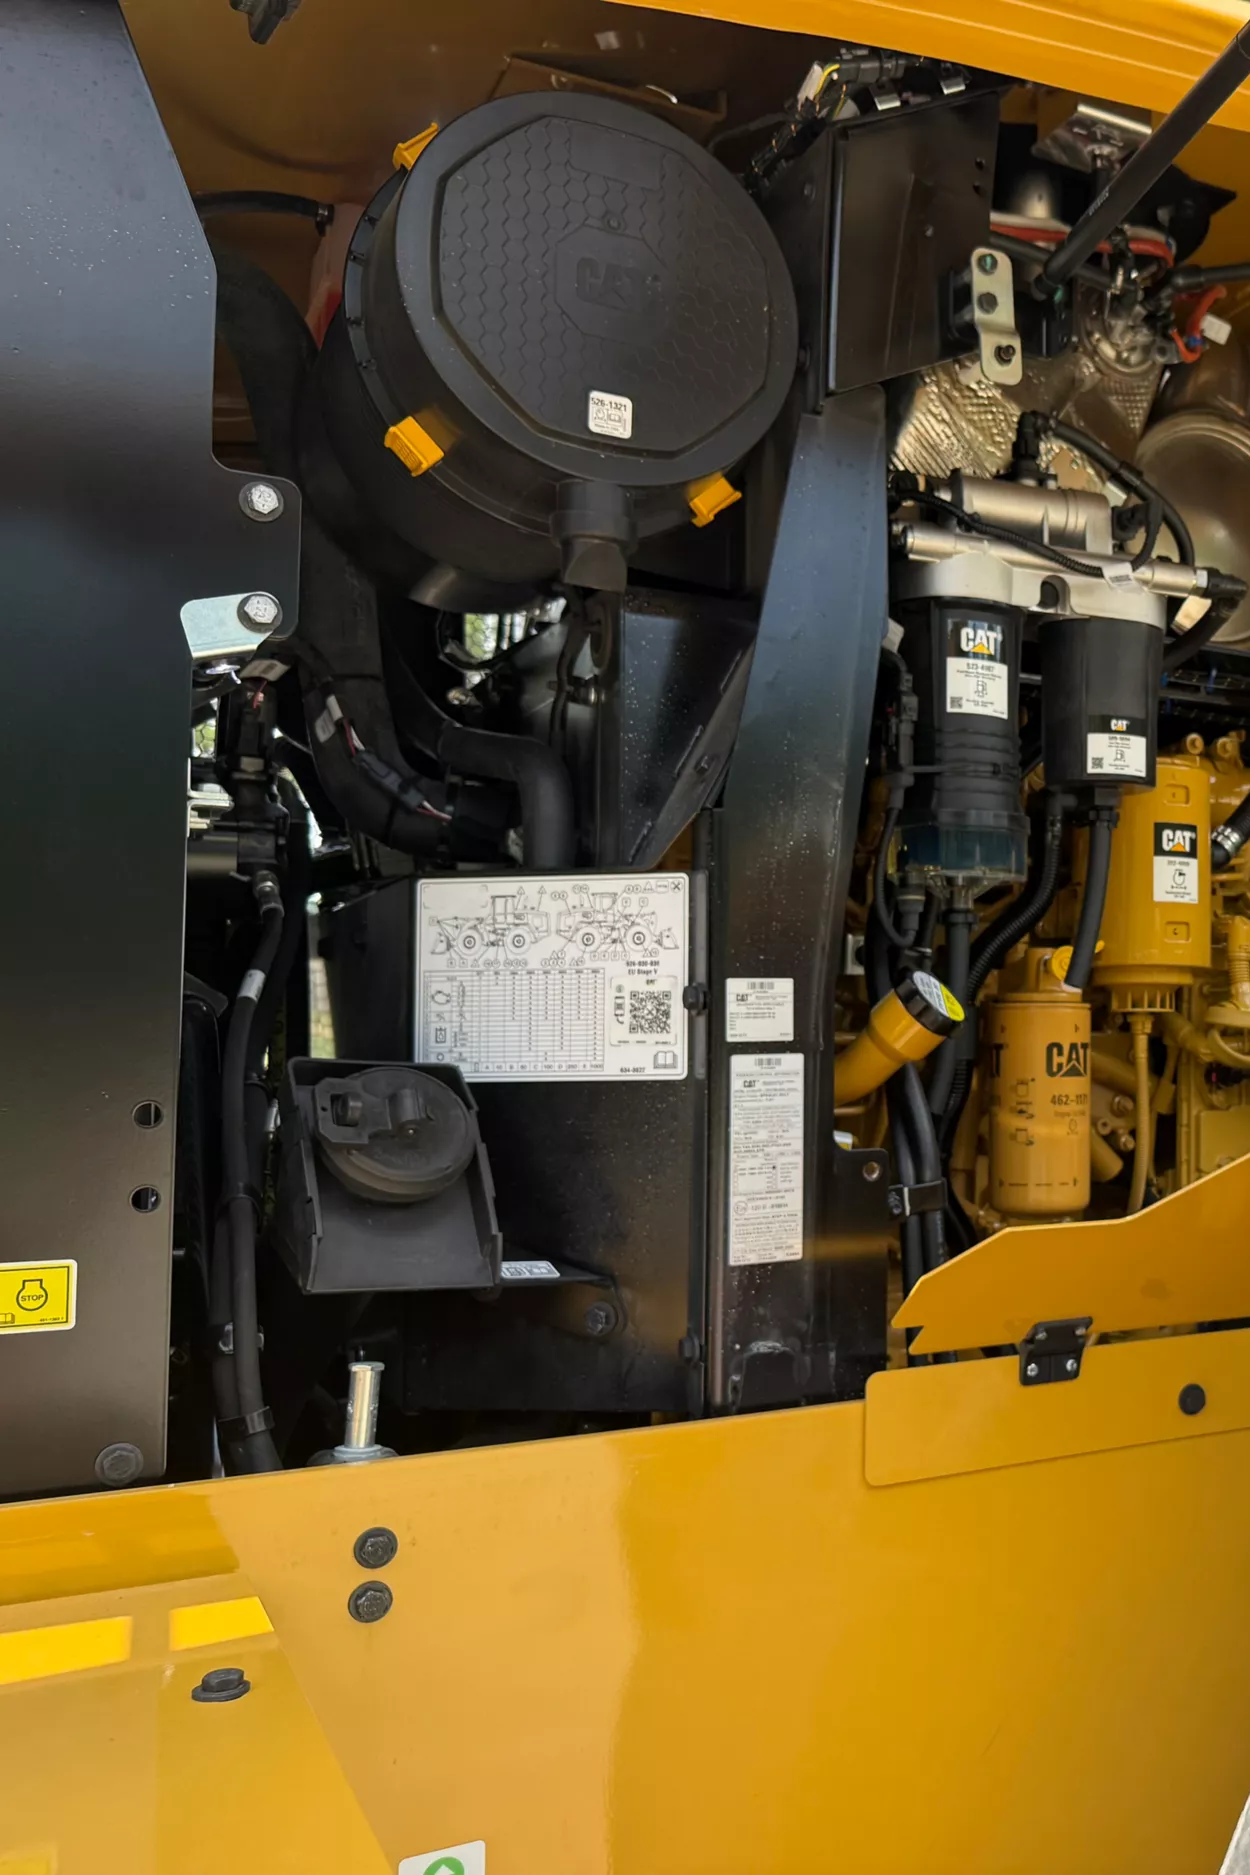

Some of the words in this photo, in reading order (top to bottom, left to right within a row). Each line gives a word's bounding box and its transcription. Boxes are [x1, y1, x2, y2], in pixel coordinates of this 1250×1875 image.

[576, 256, 640, 312] CAT
[591, 397, 627, 412] 526-1321
[961, 627, 998, 656] CAT
[1111, 719, 1128, 731] CAT
[1162, 829, 1191, 852] CAT
[736, 993, 749, 1002] CAT
[1046, 1042, 1089, 1077] CAT
[743, 1079, 756, 1088] CAT
[21, 1294, 44, 1302] STOP
